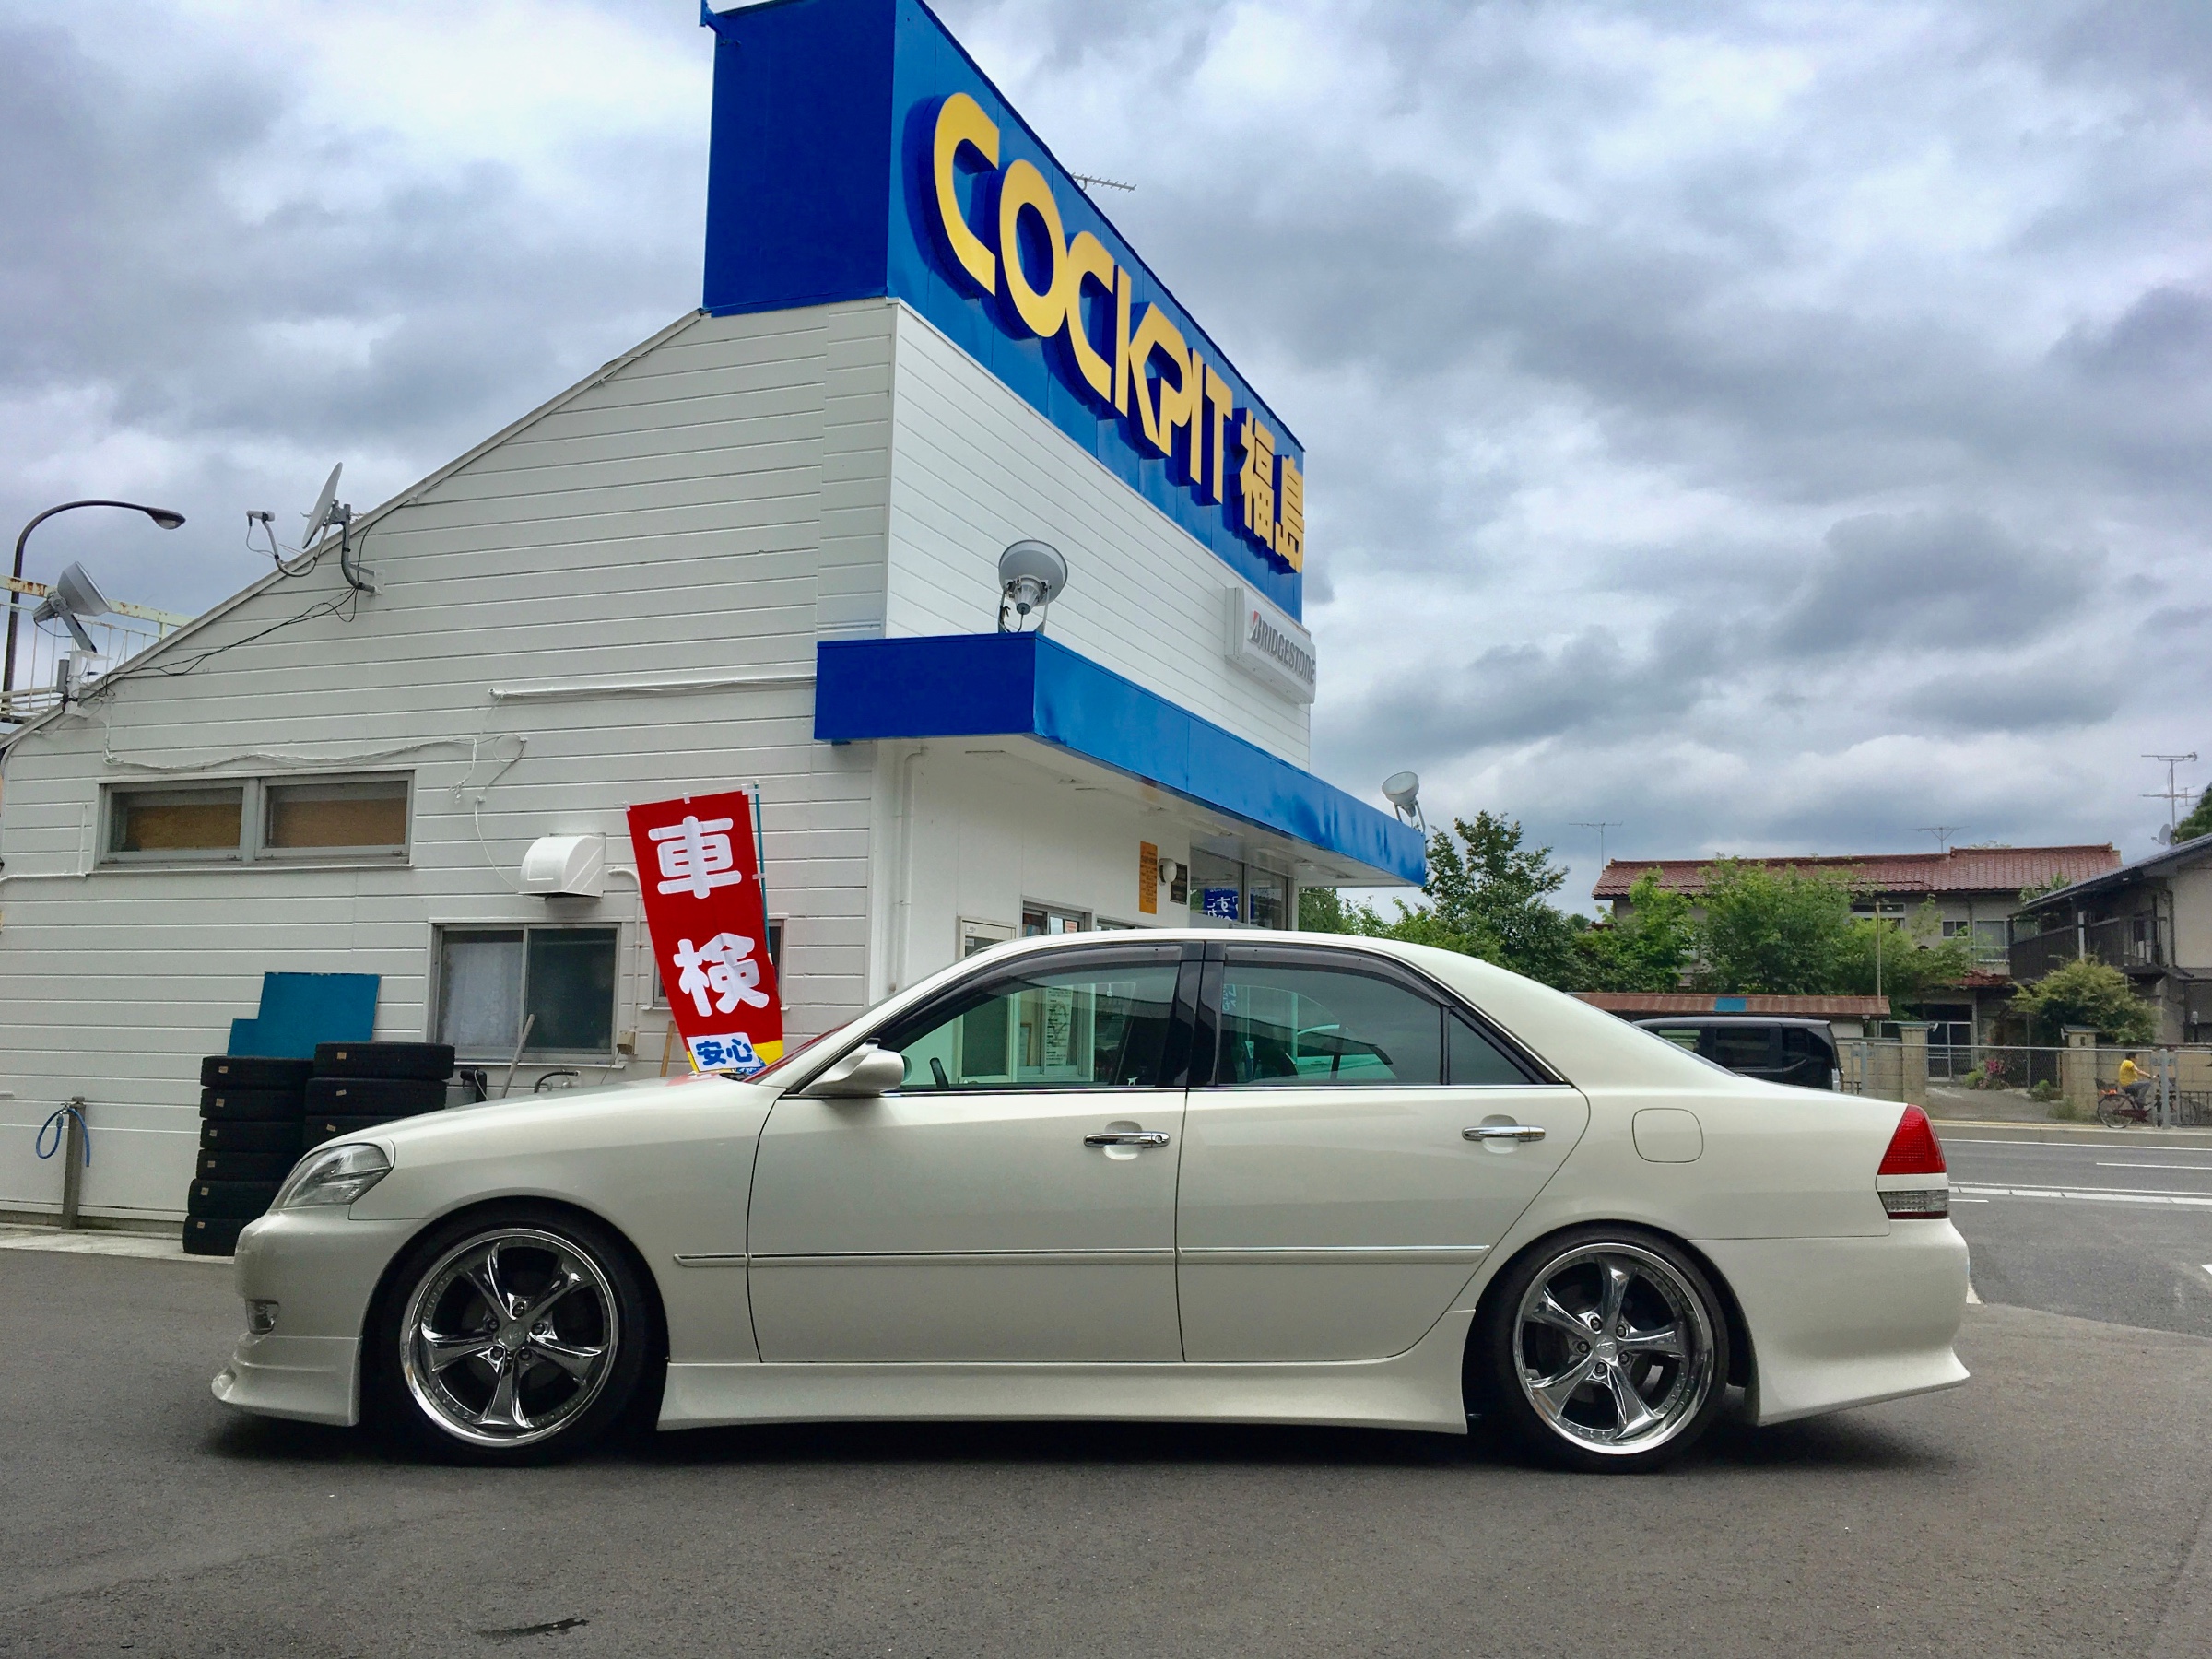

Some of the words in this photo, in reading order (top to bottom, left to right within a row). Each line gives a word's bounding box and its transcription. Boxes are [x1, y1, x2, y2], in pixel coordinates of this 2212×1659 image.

[934, 92, 1232, 505] COCKPIT
[1240, 409, 1305, 573] 福島
[1250, 610, 1316, 685] BRIDGESTONE
[648, 815, 770, 1018] 車検
[695, 1038, 753, 1066] 安心
